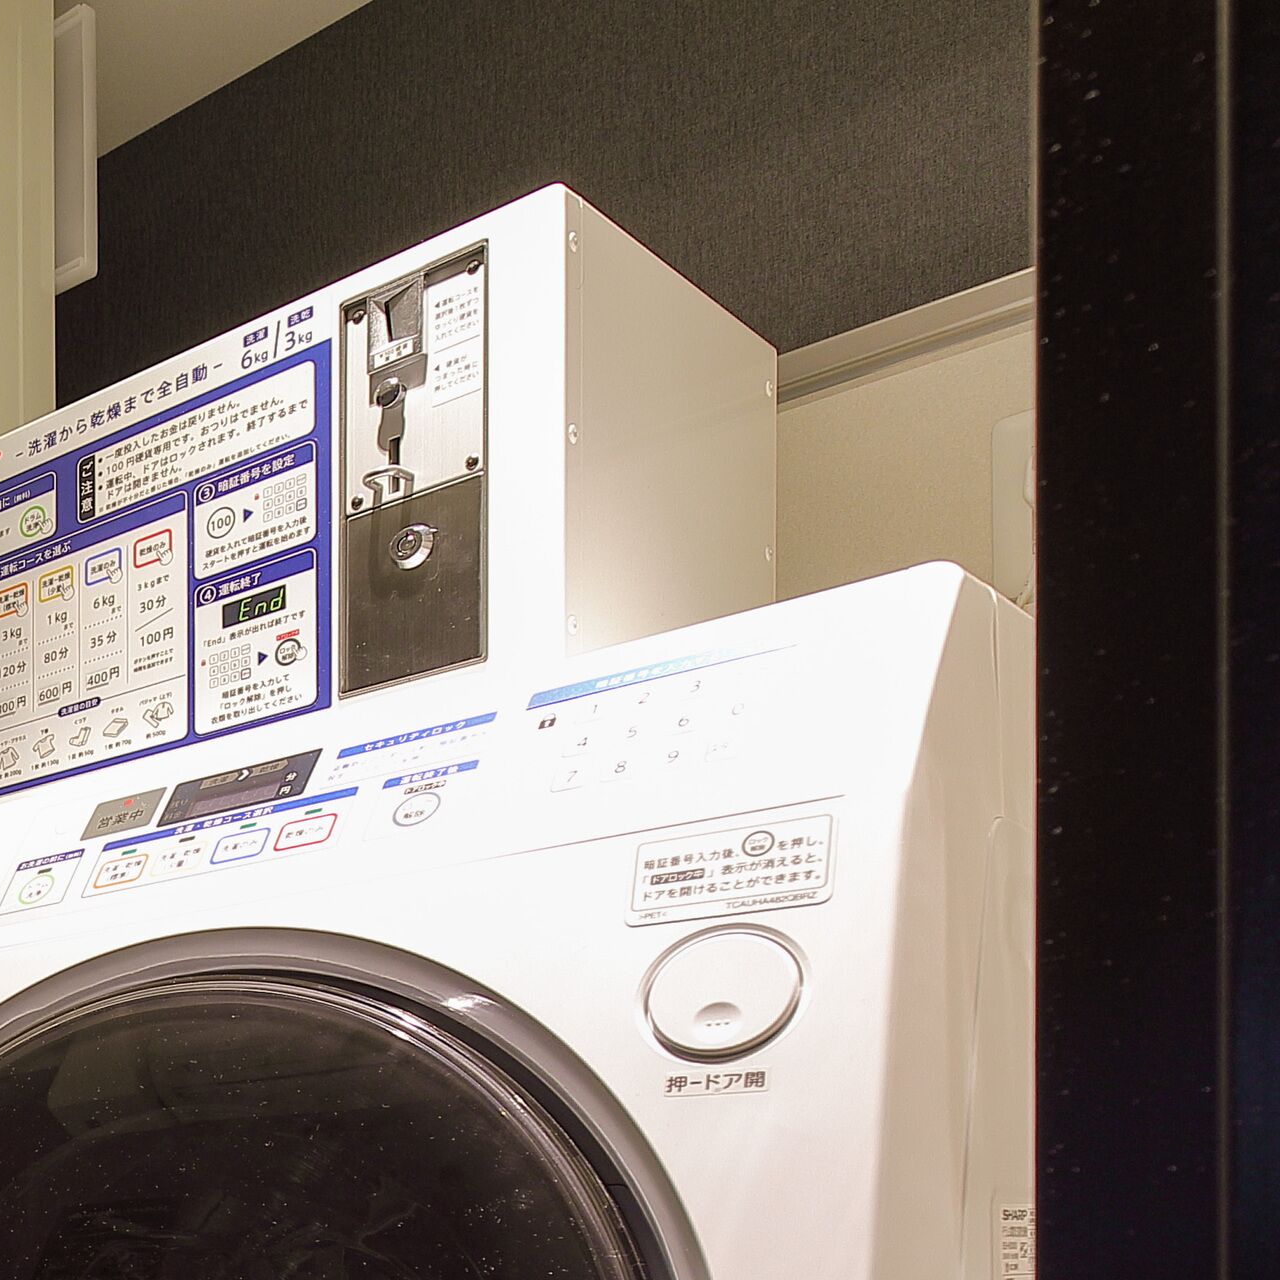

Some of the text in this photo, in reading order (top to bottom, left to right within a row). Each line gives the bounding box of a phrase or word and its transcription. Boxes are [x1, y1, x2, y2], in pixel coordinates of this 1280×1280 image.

[245, 328, 266, 345] 洗濯
[285, 329, 312, 351] 3kg
[241, 350, 268, 369] 6kg
[28, 363, 208, 457] 洗濯から乾燥まで全自動
[218, 454, 295, 492] 暗証番号を設定
[81, 459, 93, 513] ご注意
[211, 515, 231, 531] 100
[0, 540, 72, 578] 運転コースを選ぶ
[202, 526, 310, 571] スタートを押すと運転を始めます
[218, 572, 261, 597] 運転終了
[140, 595, 166, 613] 30分
[239, 588, 284, 621] End
[90, 631, 117, 649] 35分
[141, 627, 174, 647] 100円
[44, 647, 69, 664] 80分
[87, 666, 120, 685] 400円
[222, 674, 290, 698] 暗証番号を入力して
[39, 682, 72, 701] 600円
[220, 685, 292, 709] 「ロック解除」を押し
[691, 680, 701, 693] 3
[211, 694, 302, 724] 衣類を取り出してください
[364, 721, 466, 751] セキュリティロック
[285, 772, 297, 782] 分
[400, 766, 459, 784] 運転終了後
[279, 786, 291, 795] 円
[96, 808, 145, 829] 営業中
[643, 870, 821, 903] ドアを開けることができます。
